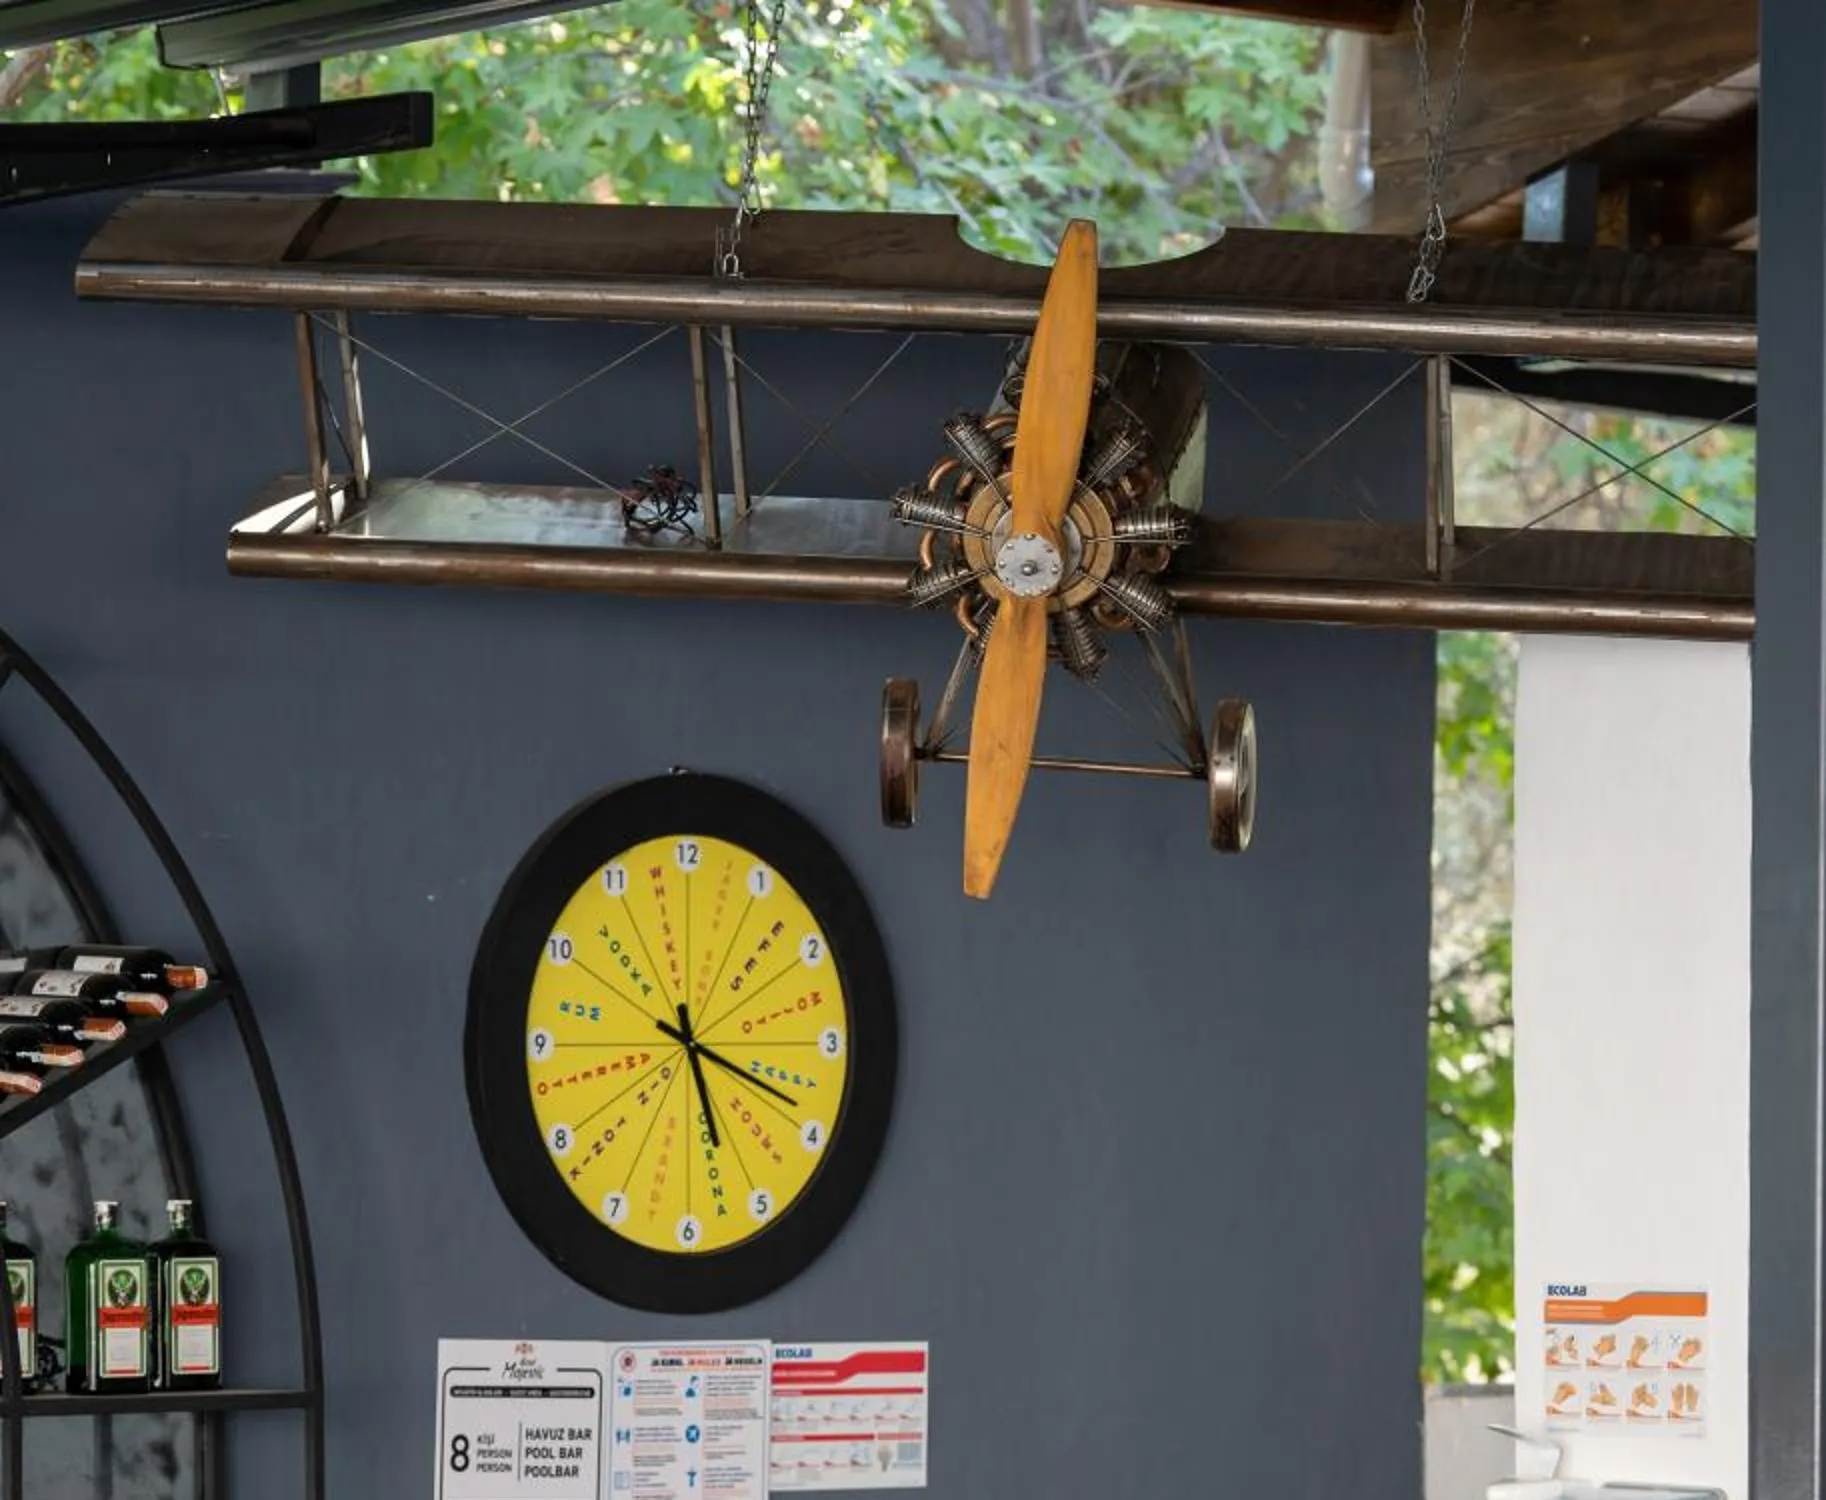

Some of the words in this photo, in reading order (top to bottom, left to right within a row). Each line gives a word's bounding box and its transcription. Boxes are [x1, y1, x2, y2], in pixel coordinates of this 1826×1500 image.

[677, 843, 699, 865] 12
[605, 868, 625, 890] 11
[756, 870, 765, 892] 1
[649, 866, 682, 991] WHISKEY
[550, 939, 573, 960] 10
[729, 920, 785, 992] EFES
[807, 938, 820, 959] 2
[559, 1001, 601, 1021] RUM
[741, 991, 823, 1034] MOJITO
[534, 1034, 546, 1055] 9
[826, 1032, 838, 1053] 3
[750, 1060, 817, 1089] HAPPY
[636, 1066, 671, 1105] GIN
[554, 1128, 568, 1150] 8
[729, 1096, 783, 1164] HOURS
[807, 1125, 818, 1145] 4
[569, 1116, 627, 1181] TONIK
[698, 1111, 728, 1217] CORONA
[609, 1197, 621, 1218] 7
[755, 1194, 768, 1215] 5
[682, 1221, 695, 1241] 6
[1547, 1285, 1587, 1296] ECOLAB
[525, 1427, 565, 1441] HAVUZ
[567, 1428, 593, 1441] BAR
[450, 1433, 470, 1473] 8
[476, 1448, 513, 1460] PERSON
[524, 1446, 556, 1460] POOL
[559, 1446, 583, 1460] BAR
[476, 1462, 513, 1473] PERSON
[524, 1465, 579, 1478] POOLBAR
